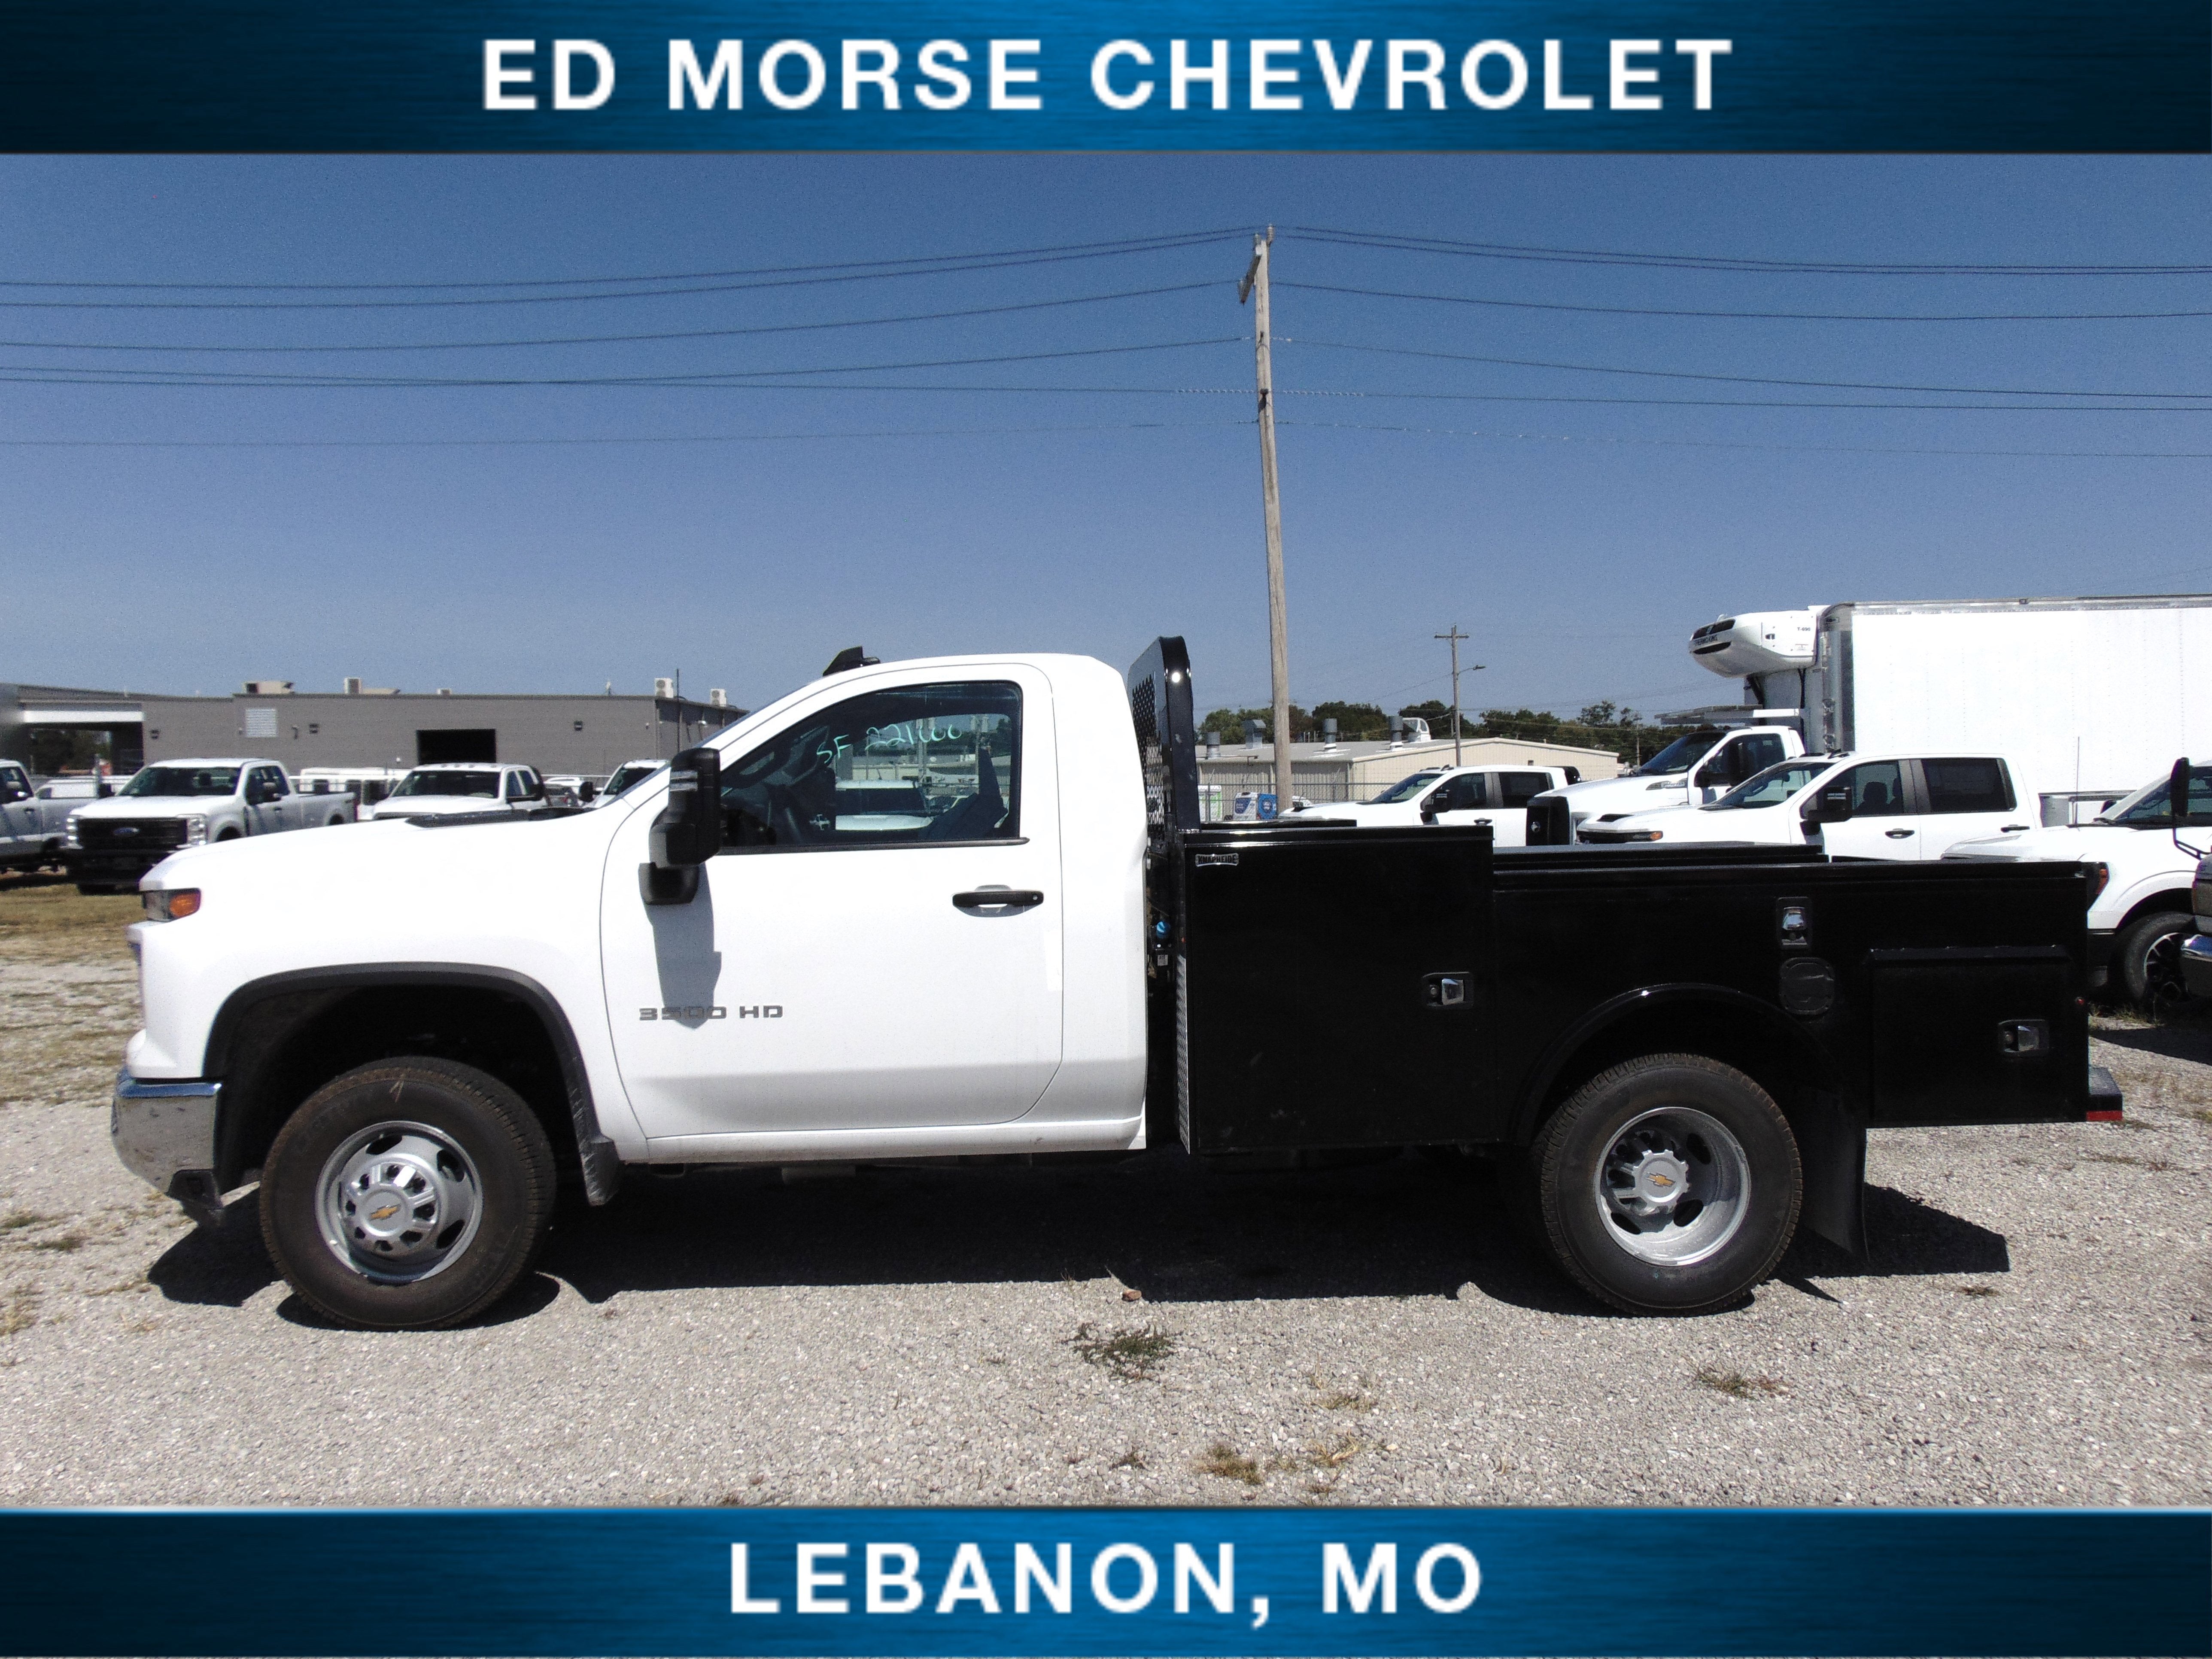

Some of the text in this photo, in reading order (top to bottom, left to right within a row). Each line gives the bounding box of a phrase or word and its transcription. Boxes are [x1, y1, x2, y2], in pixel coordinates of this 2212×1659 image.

[1198, 854, 1237, 864] KNAPHEIDE
[639, 1005, 783, 1021] 3500 HD
